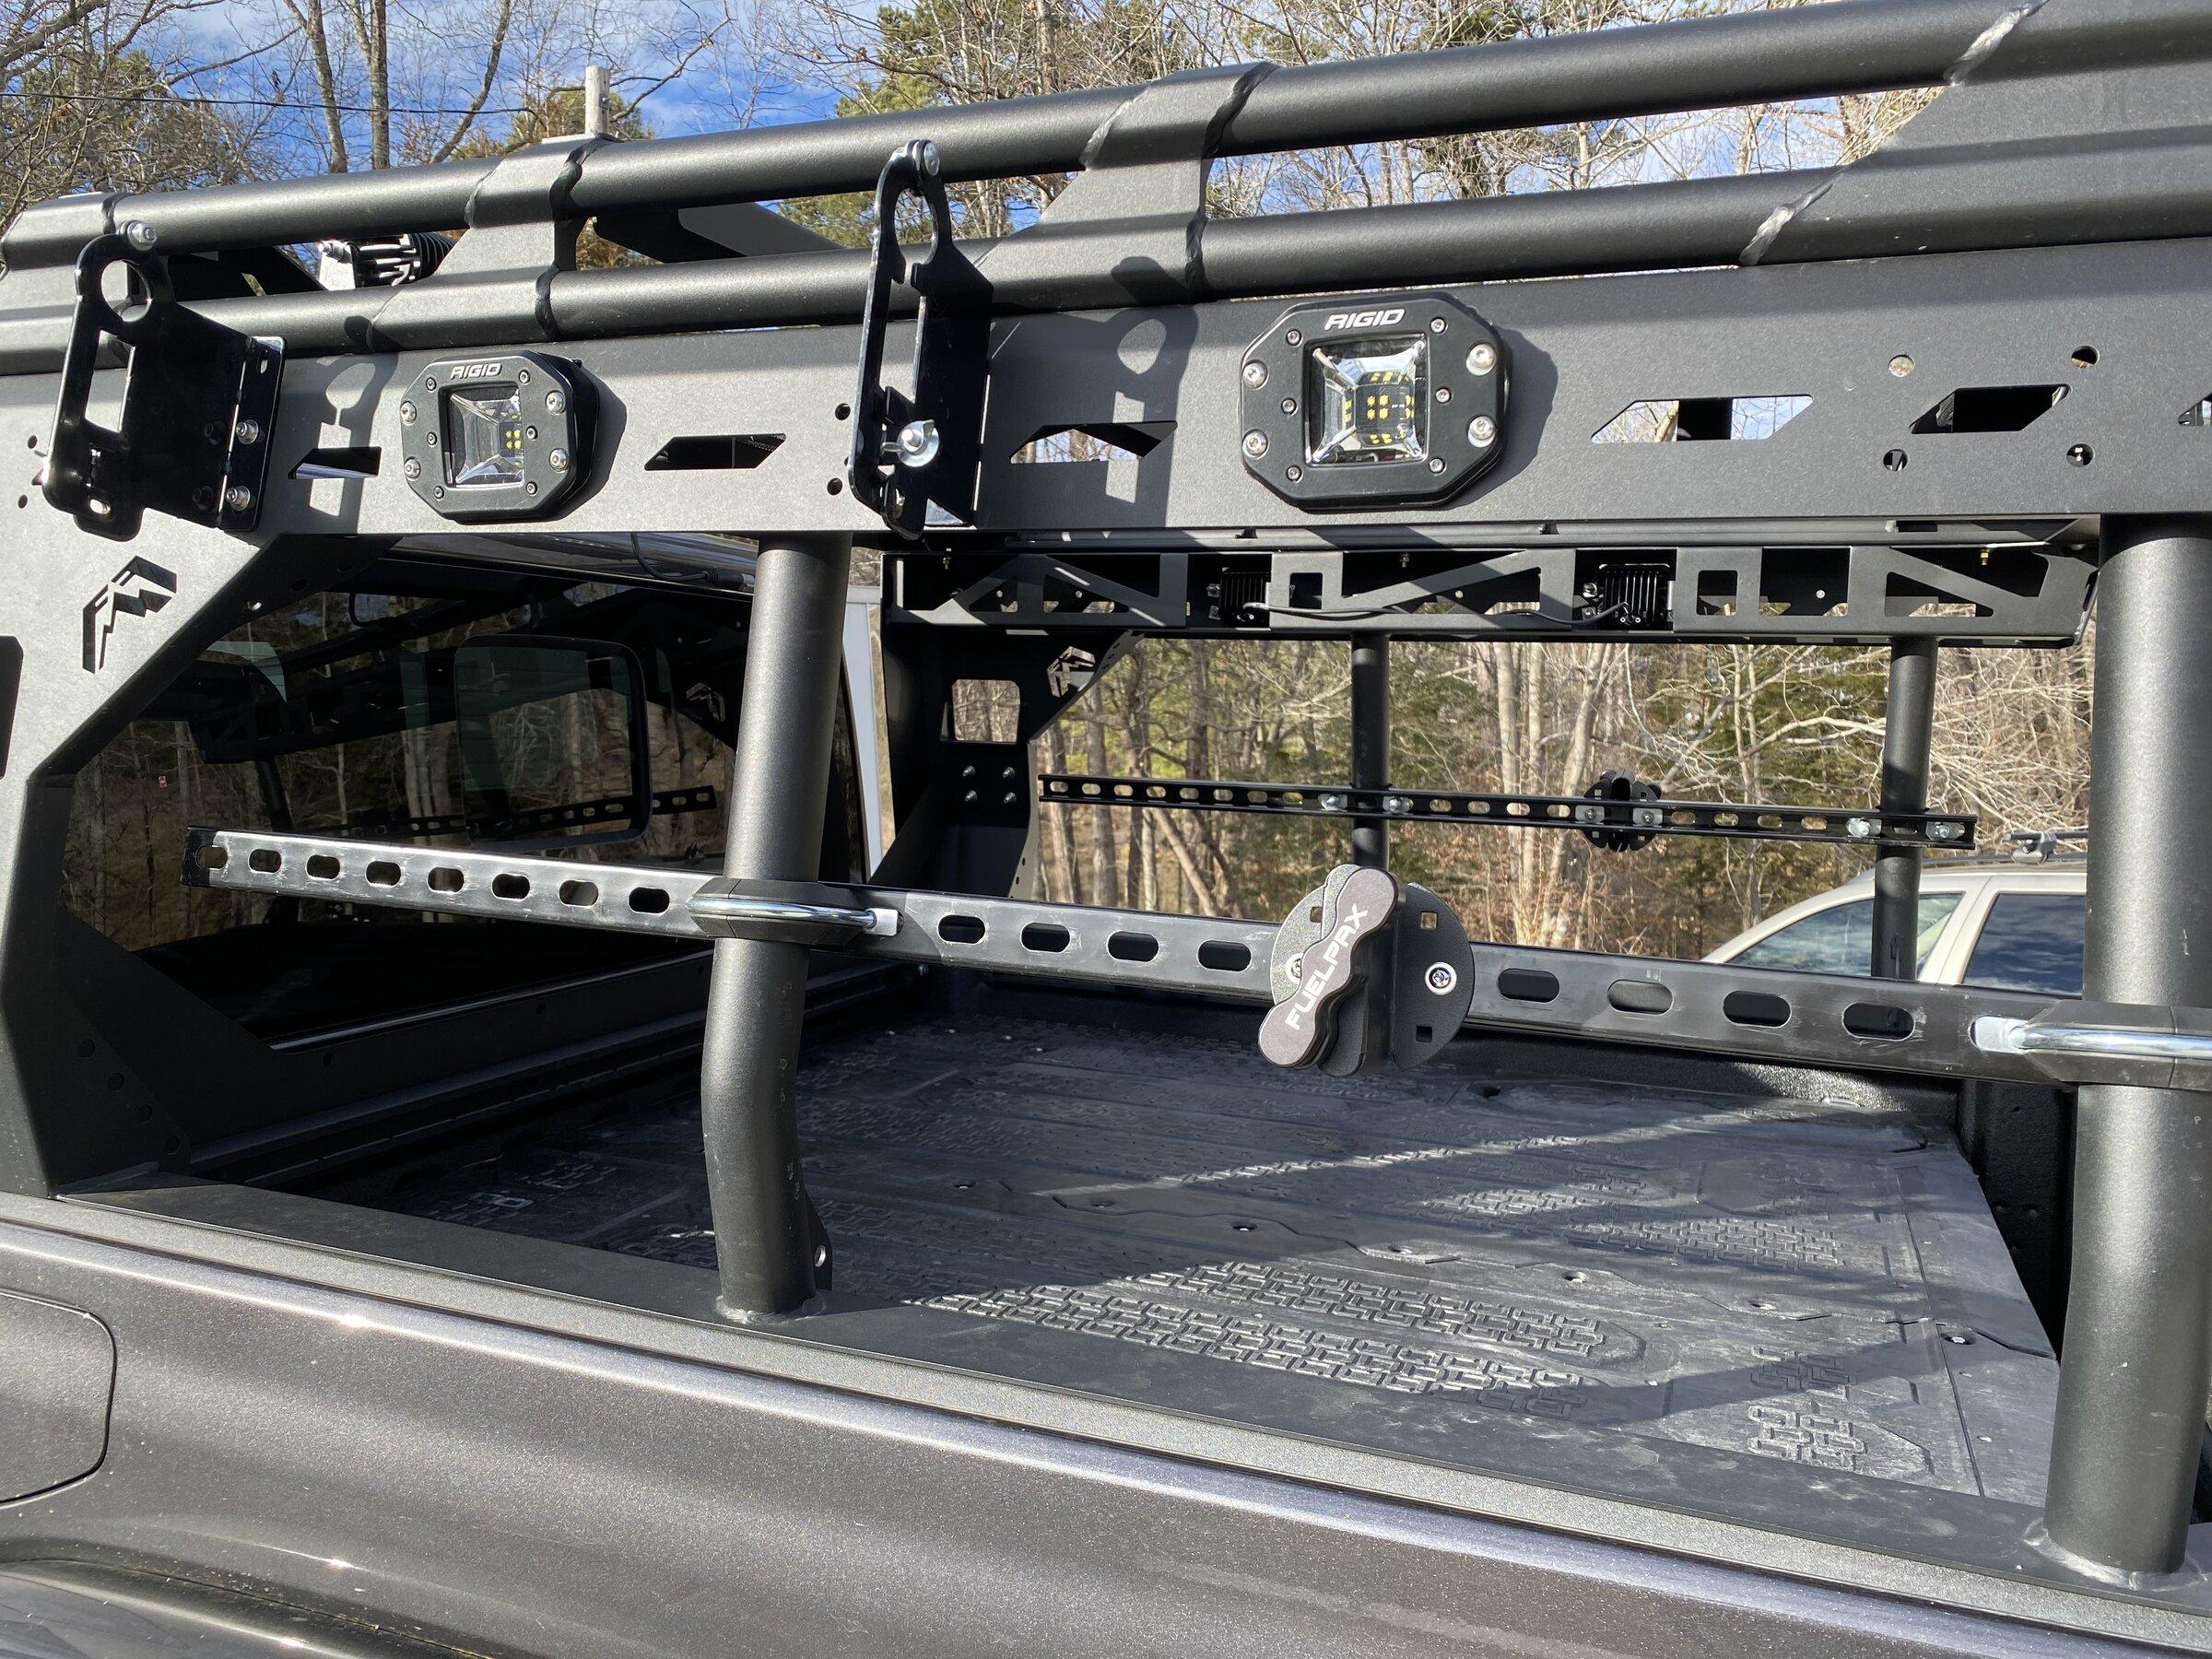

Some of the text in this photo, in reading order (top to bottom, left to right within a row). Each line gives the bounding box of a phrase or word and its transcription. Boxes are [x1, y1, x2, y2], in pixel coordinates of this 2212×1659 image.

[1324, 308, 1406, 331] RIGID
[450, 362, 502, 380] RIGID
[1285, 902, 1369, 1031] FUELPAX
